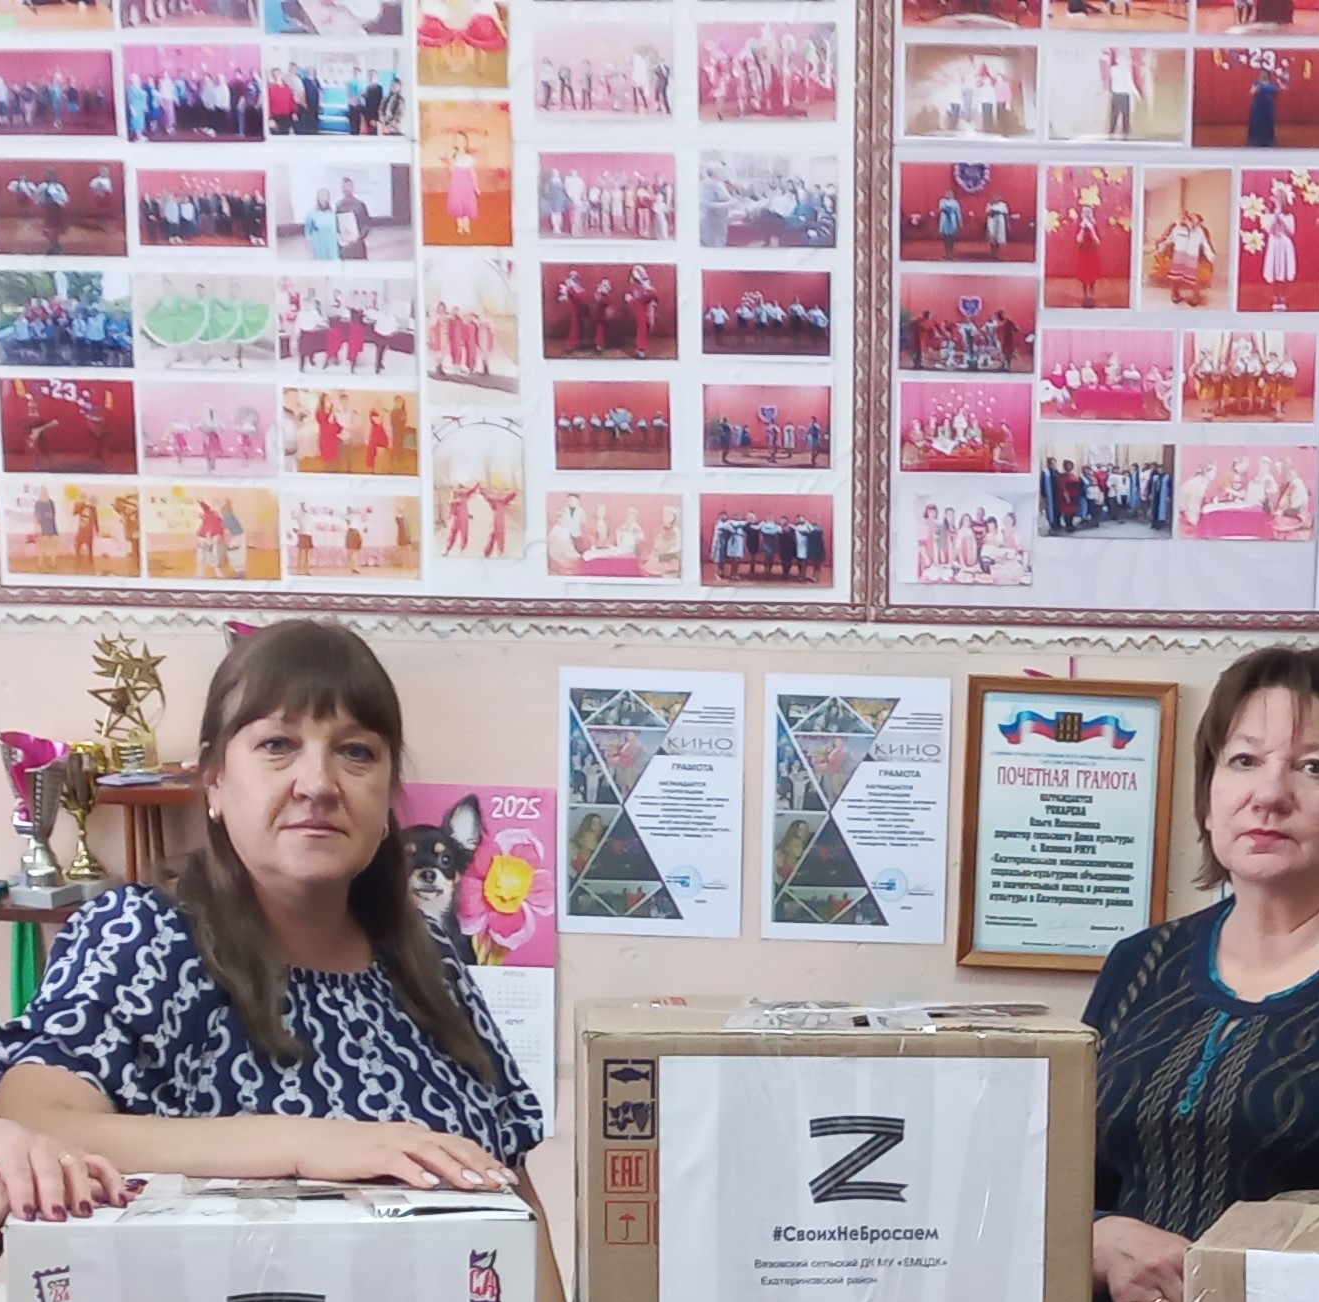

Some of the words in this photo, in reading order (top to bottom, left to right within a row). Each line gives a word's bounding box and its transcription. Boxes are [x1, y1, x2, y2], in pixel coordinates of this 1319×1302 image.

[1248, 48, 1276, 70] 23
[49, 380, 78, 401] 23
[667, 737, 733, 750] КИНО
[874, 744, 941, 756] КИНО
[671, 763, 714, 772] ГРАМОТА
[879, 770, 921, 778] ГРАМОТА
[997, 766, 1069, 787] ПОЧЕТНАЯ
[1076, 769, 1137, 790] ГРАМОТА
[491, 795, 542, 820] 2025
[773, 1225, 939, 1243] #СвоихНеБросаем
[860, 1258, 874, 1268] ДК
[877, 1258, 894, 1267] МУ
